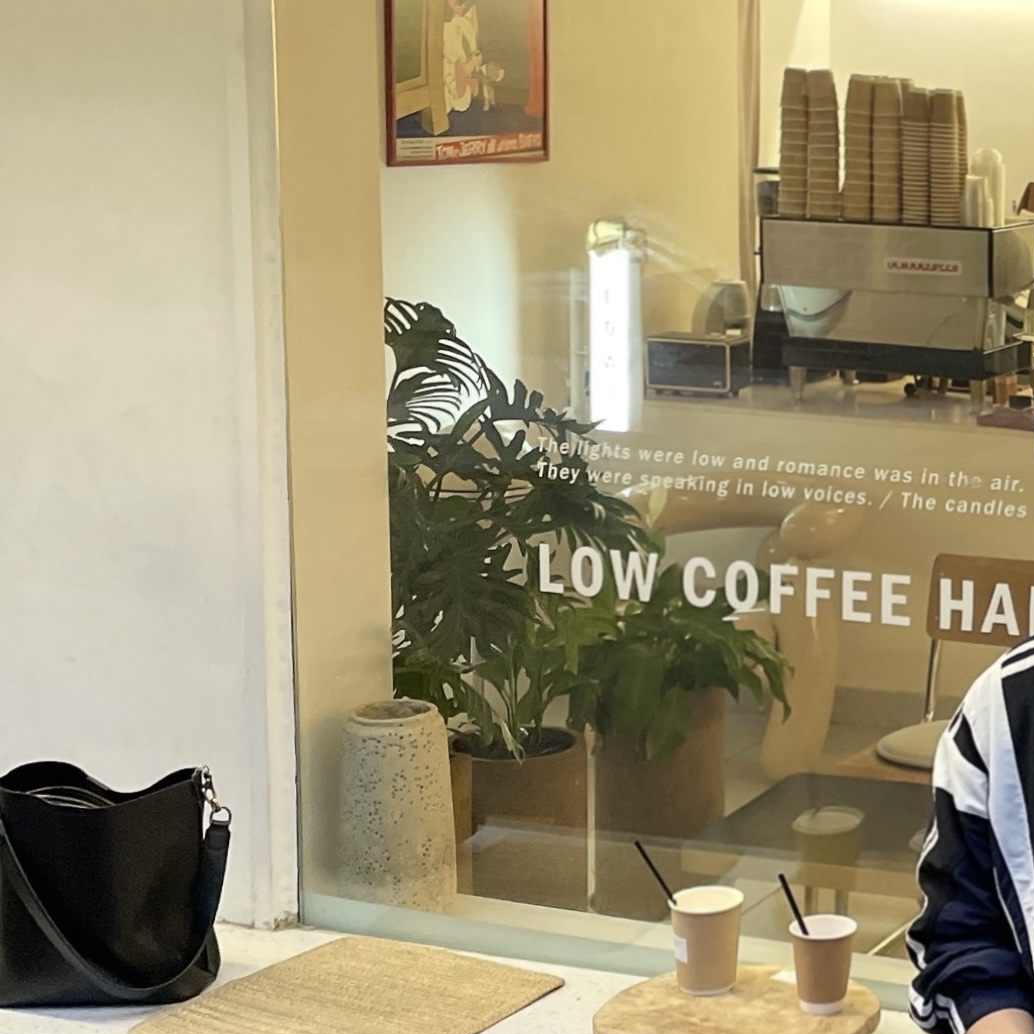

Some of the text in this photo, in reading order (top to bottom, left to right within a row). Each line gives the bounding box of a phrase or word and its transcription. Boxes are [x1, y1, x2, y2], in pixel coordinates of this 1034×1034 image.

[538, 436, 1024, 493] The lights were low and romance was in the air.
[538, 462, 580, 484] They
[587, 469, 632, 486] were
[640, 473, 730, 497] speaking
[736, 478, 753, 496] in
[762, 480, 796, 499] low
[803, 485, 872, 506] voices.
[900, 492, 936, 511] The
[945, 499, 1027, 518] candles
[539, 543, 658, 603] LOW
[683, 556, 911, 627] COFFEE
